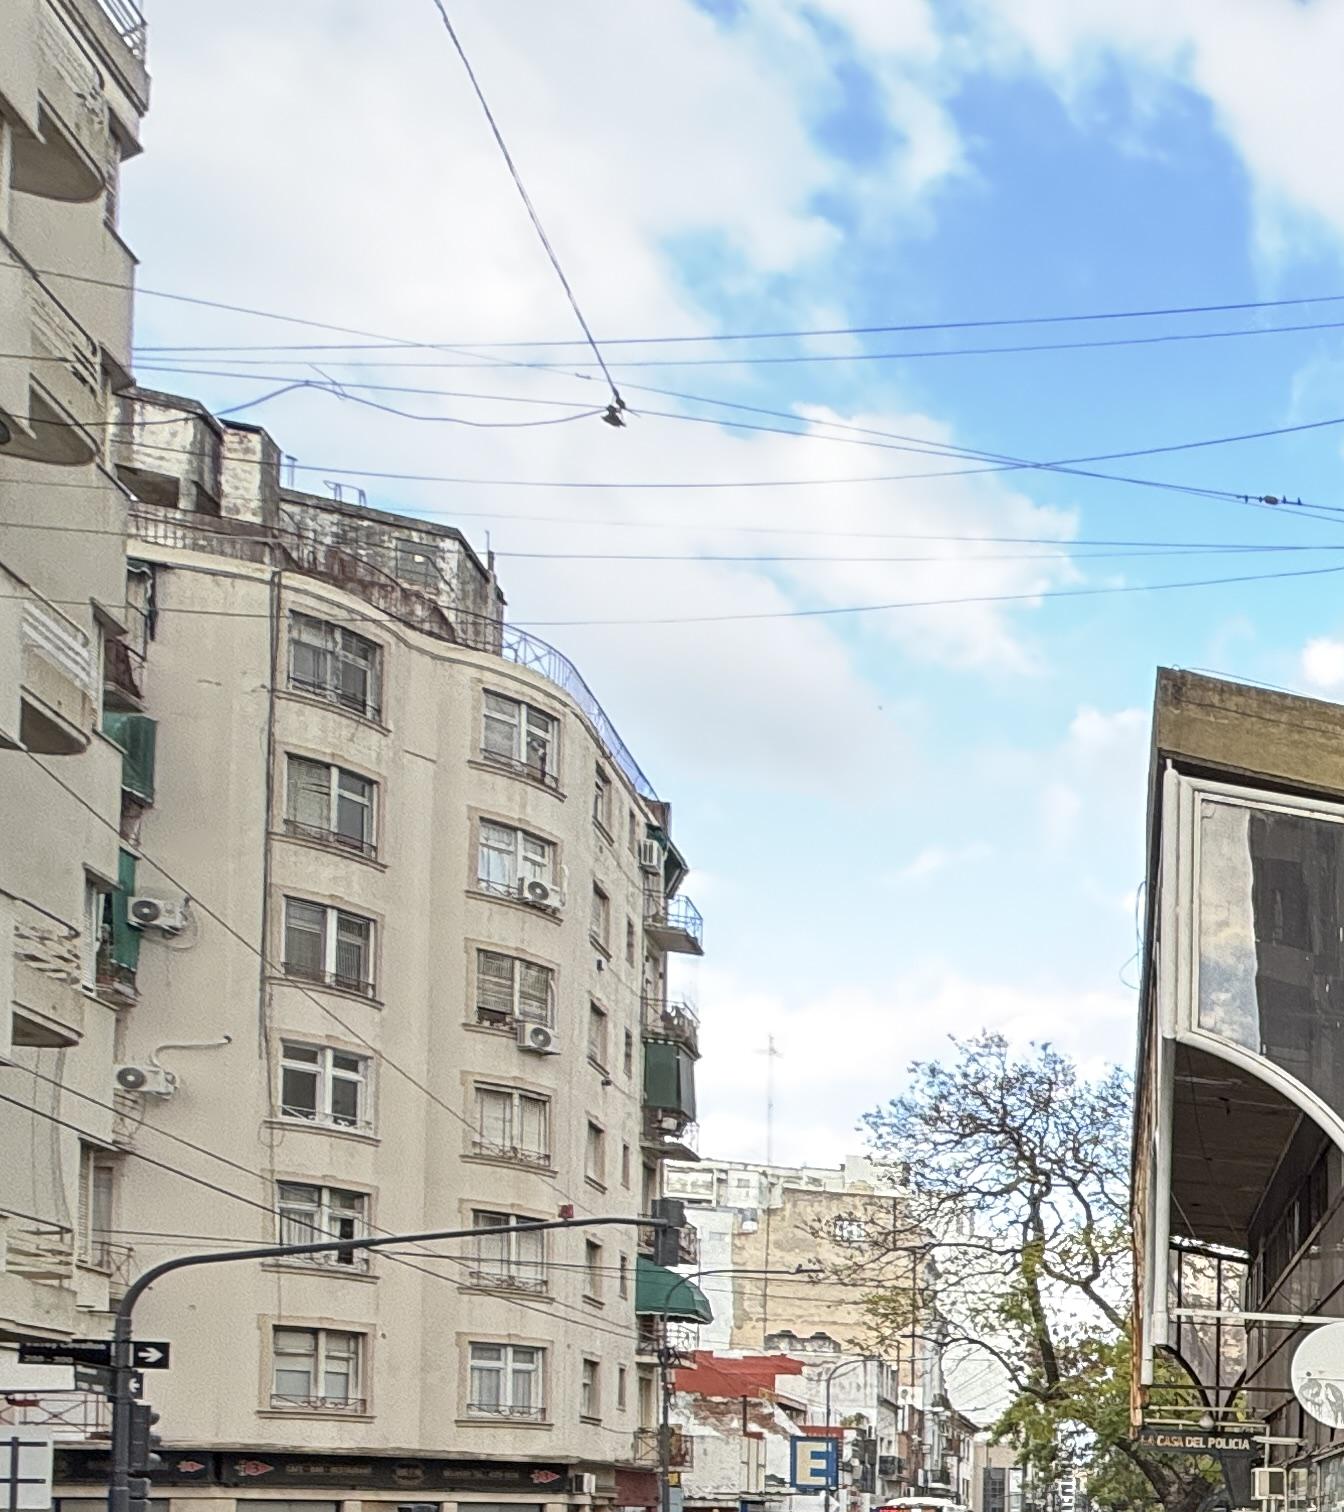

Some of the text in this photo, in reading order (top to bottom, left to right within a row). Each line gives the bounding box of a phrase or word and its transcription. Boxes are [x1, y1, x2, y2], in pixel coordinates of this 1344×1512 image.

[1141, 1435, 1250, 1450] LA CASA DEL POLICIA
[796, 1441, 832, 1485] E
